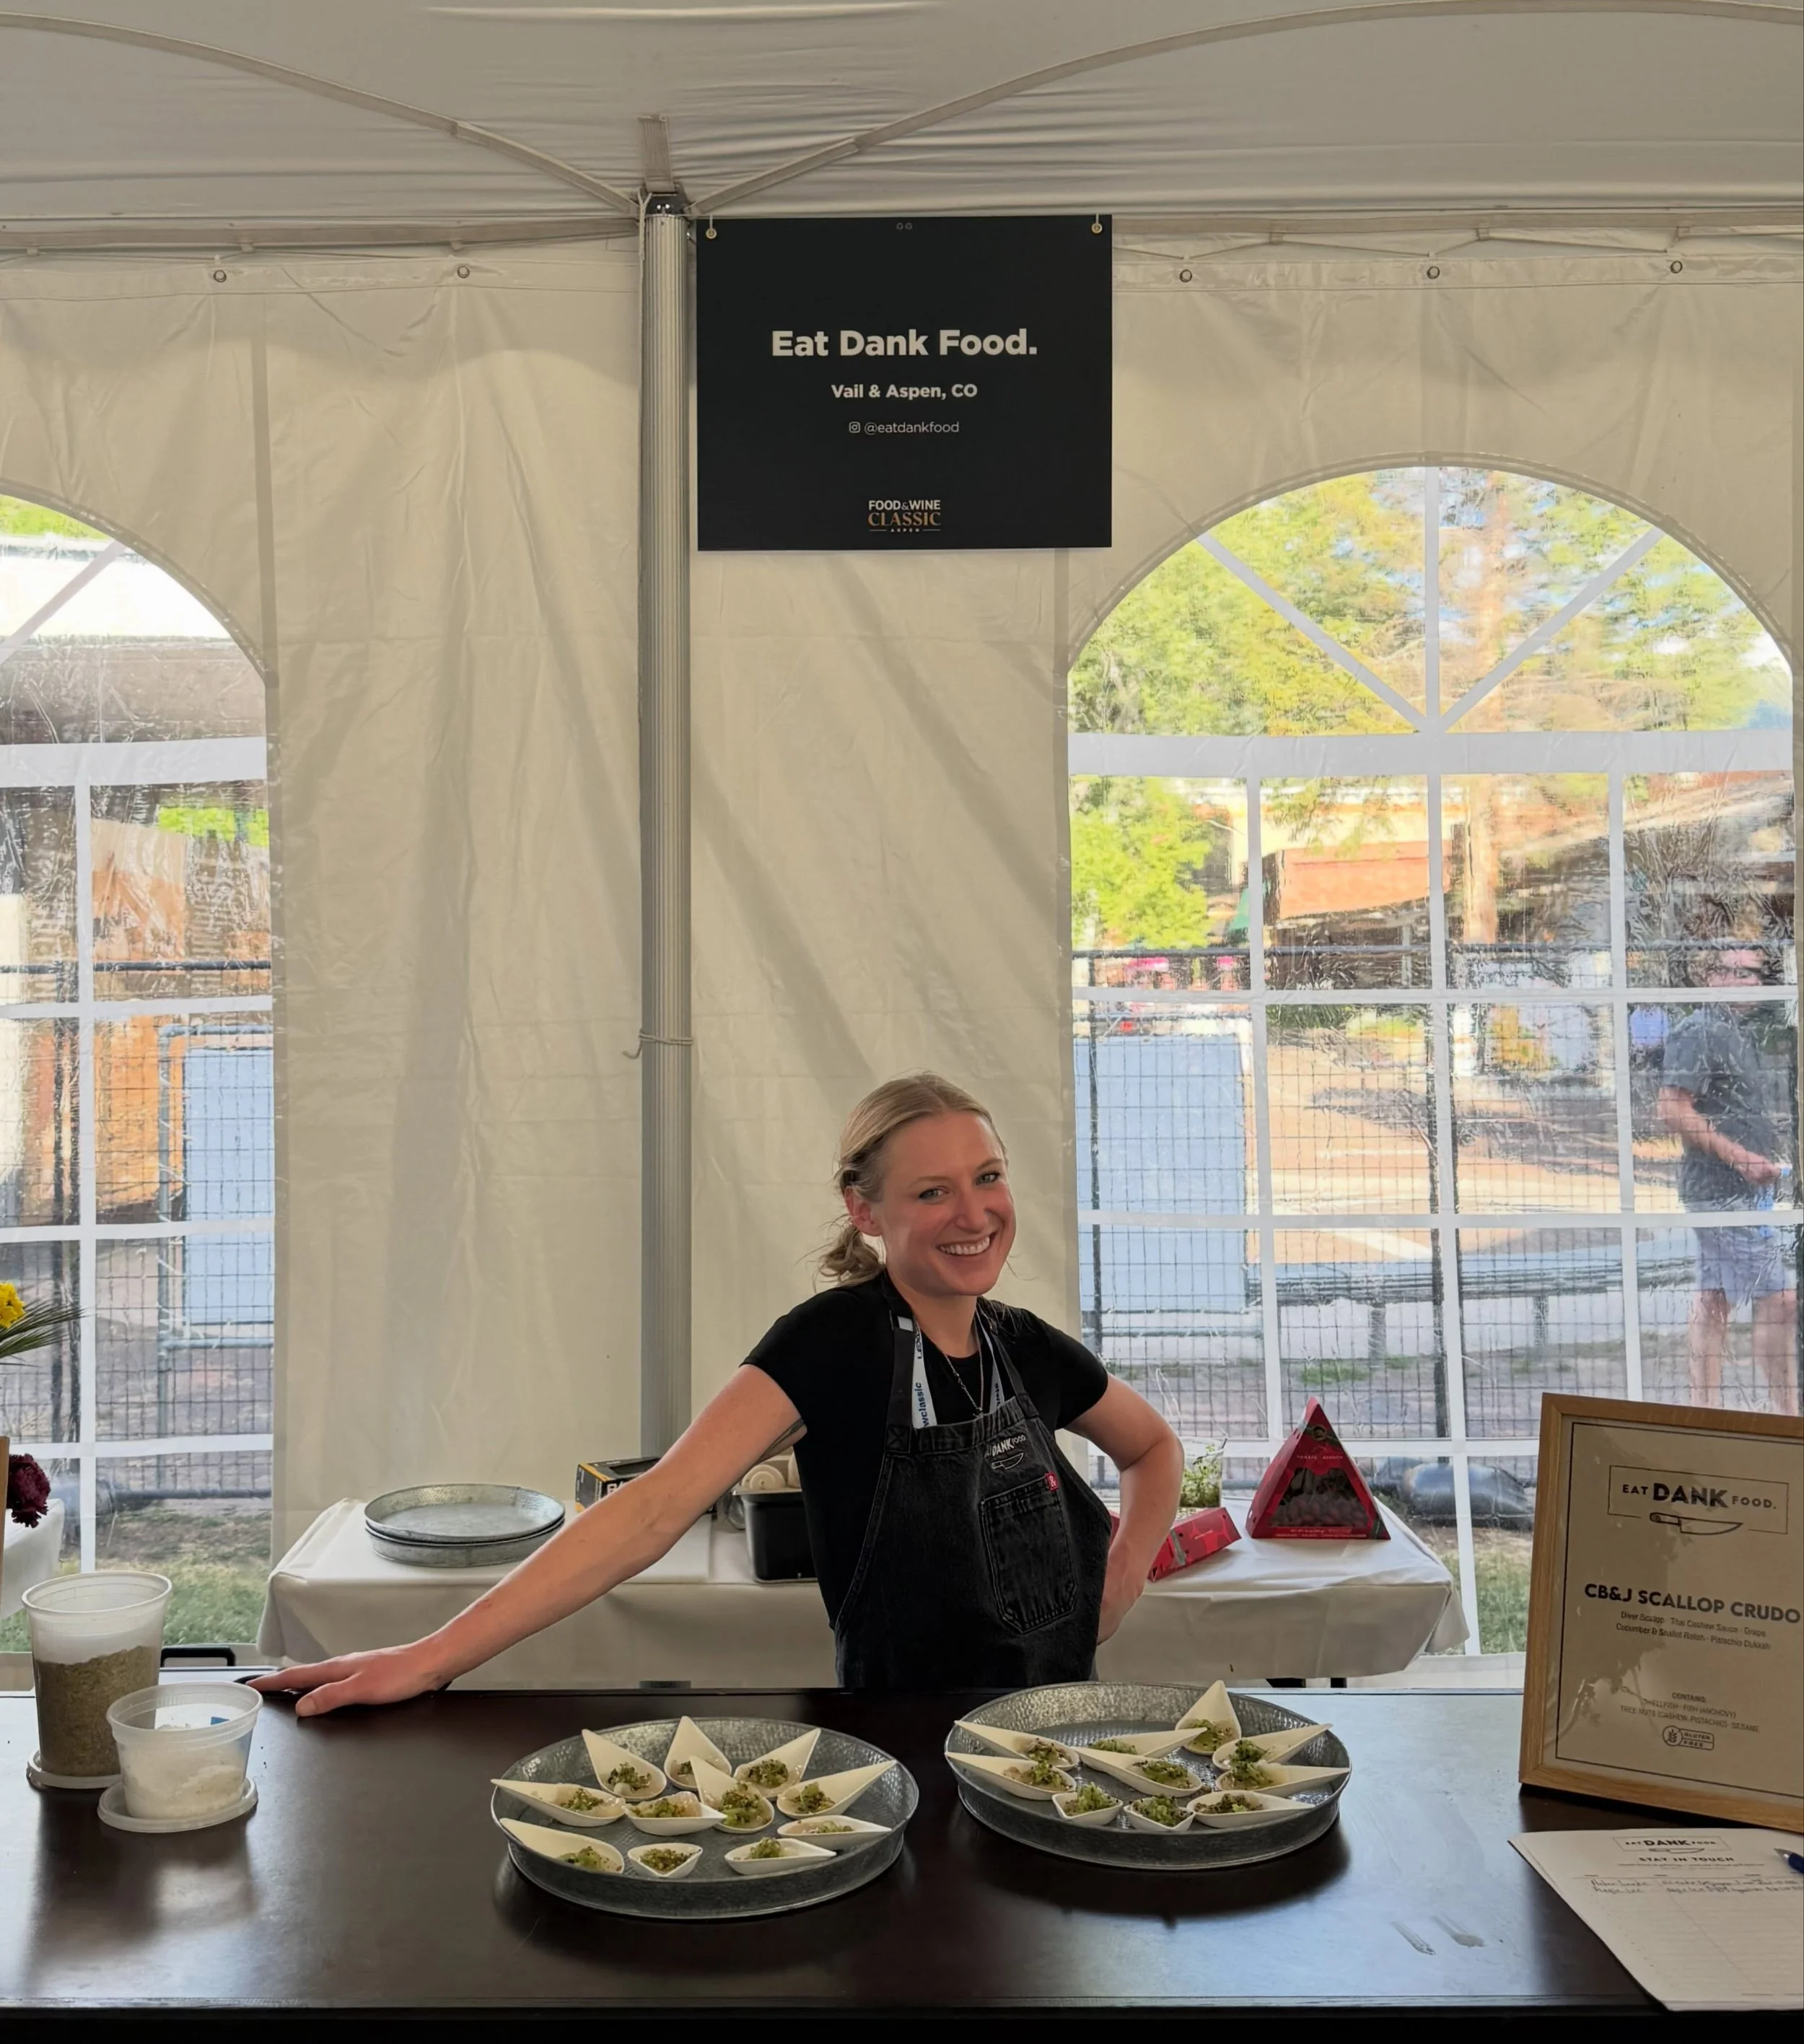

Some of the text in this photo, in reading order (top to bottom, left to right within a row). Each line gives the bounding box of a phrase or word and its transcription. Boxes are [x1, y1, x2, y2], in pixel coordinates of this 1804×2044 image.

[773, 328, 1037, 356] Eat Dank Food.
[831, 384, 977, 401] Vail & Aspen, CO
[864, 422, 959, 434] @eatdankfood
[868, 512, 940, 525] CLASSIC
[991, 1438, 1015, 1456] DANK
[1622, 1482, 1778, 1510] EAT DANK FOOD.
[1584, 1583, 1801, 1625] CB&J SCALLOP CRUDO
[1671, 1617, 1686, 1628] Thai
